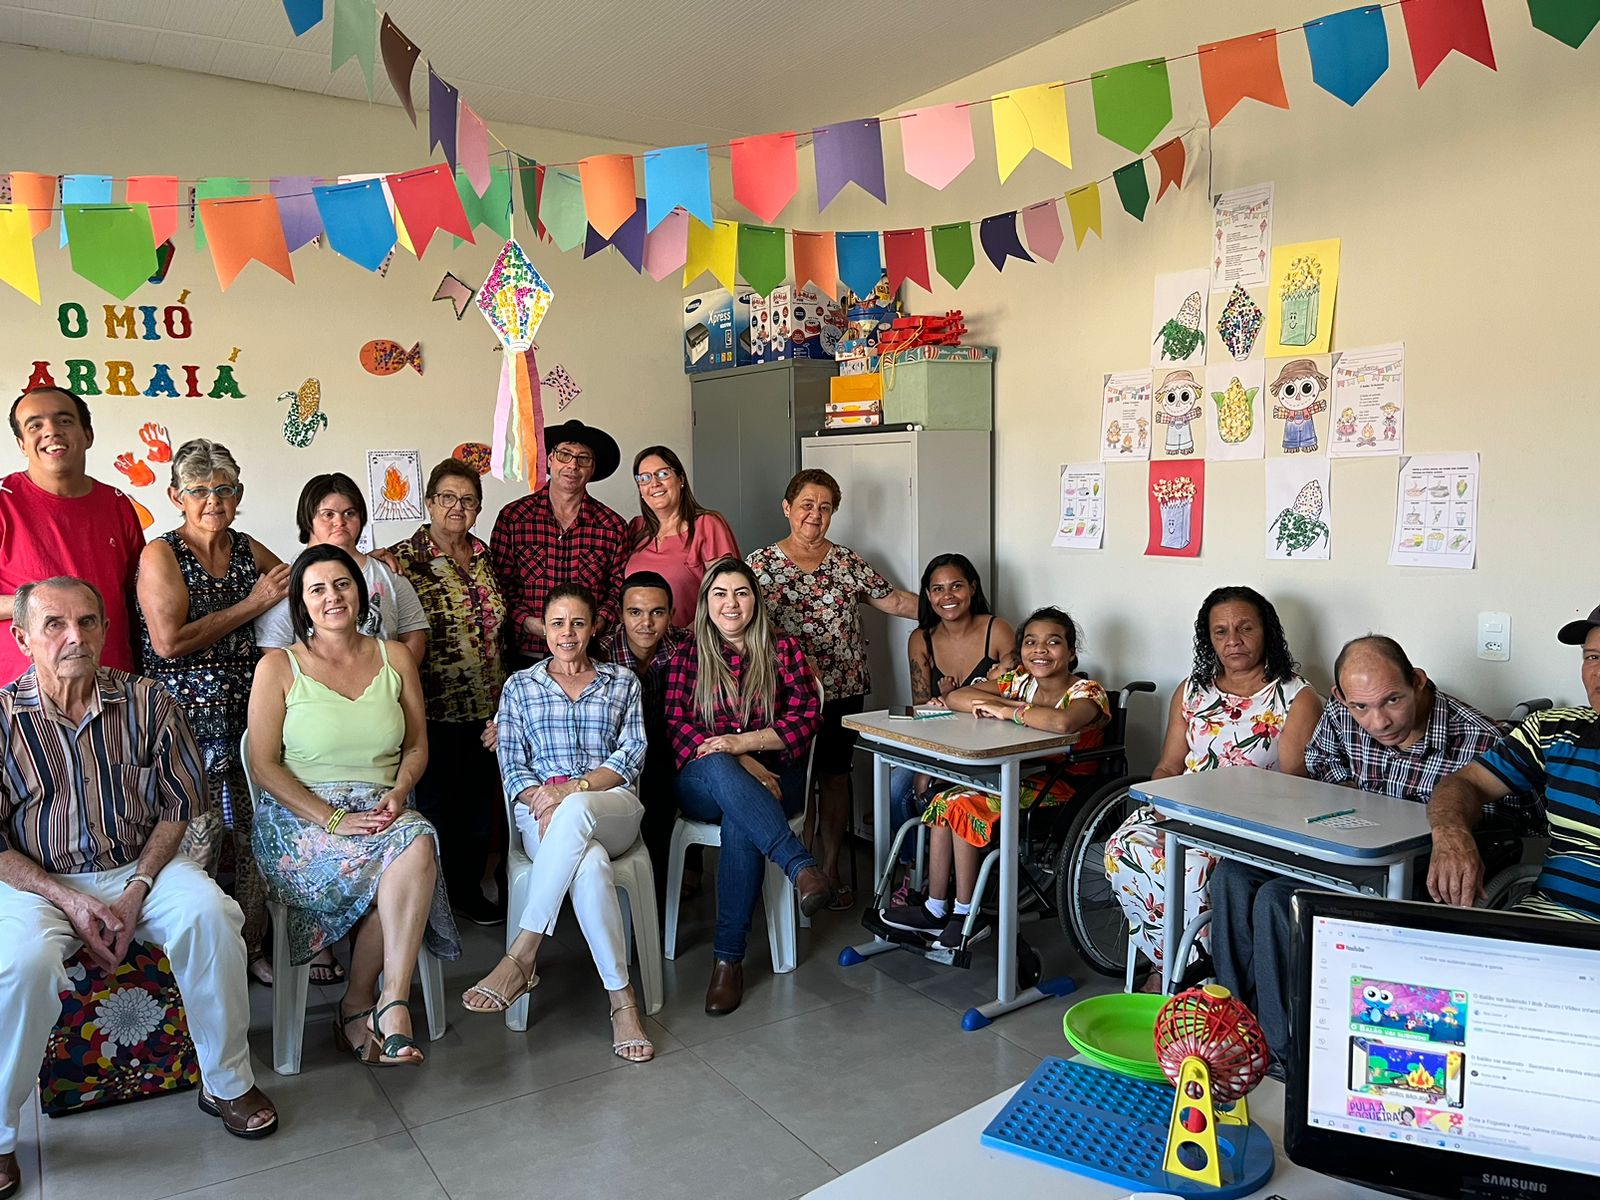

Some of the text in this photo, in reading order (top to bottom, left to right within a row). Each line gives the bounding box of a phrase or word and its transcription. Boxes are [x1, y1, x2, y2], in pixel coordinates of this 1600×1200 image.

[57, 288, 192, 341] O MIÓ
[708, 310, 731, 326] Xpress
[21, 346, 247, 399] ARRAIÁ
[1350, 1101, 1376, 1112] PULA
[1482, 1173, 1547, 1193] SAMSUNG
